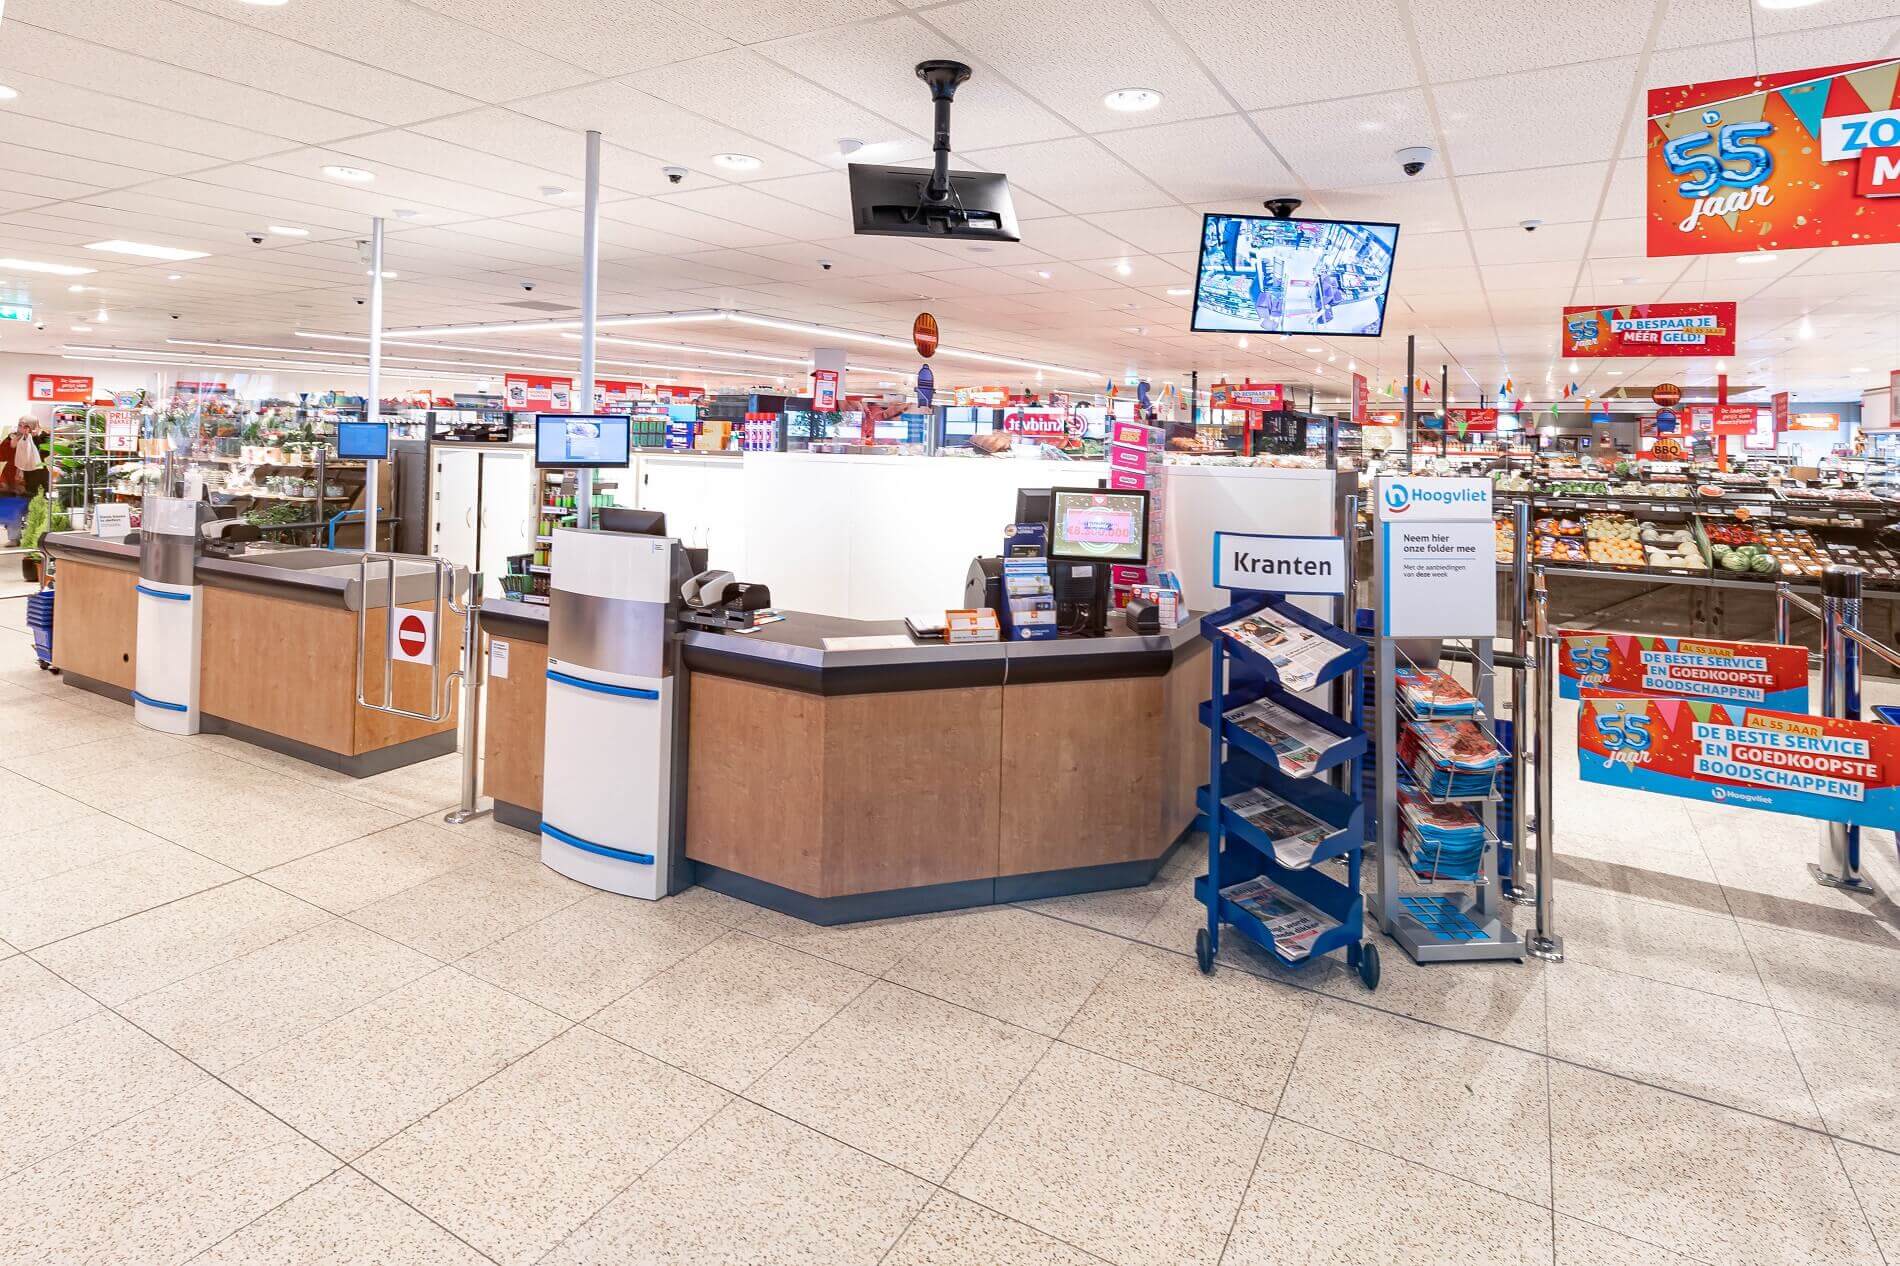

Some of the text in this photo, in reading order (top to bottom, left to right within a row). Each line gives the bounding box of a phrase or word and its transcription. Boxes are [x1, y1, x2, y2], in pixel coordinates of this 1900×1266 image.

[1663, 121, 1774, 199] 55
[1679, 184, 1775, 233] jaar
[1568, 319, 1600, 341] 55
[1616, 317, 1712, 331] ZO BESPAAR JE
[1623, 330, 1702, 343] MÉÉR GELD!
[1654, 445, 1680, 456] BBQ
[1411, 488, 1487, 504] Hoogvliet
[1403, 533, 1450, 543] Neem hier
[1403, 544, 1476, 553] onze folder mee
[1234, 551, 1332, 576] Kranten
[1426, 564, 1466, 572] aanbiedingen
[1681, 644, 1731, 657] AL 55 JAAR
[1569, 647, 1611, 675] 55
[1644, 653, 1764, 669] DE BESTE SERVICE
[1576, 672, 1612, 688] jaar
[1650, 665, 1775, 685] EN GOEDKOOPSTE
[1645, 677, 1760, 700] BOODSCHAPPEN!
[1595, 713, 1652, 751] 55
[1751, 717, 1818, 737] AL 55 JAAR
[1697, 725, 1864, 756] DE BESTE SERVICE
[1602, 746, 1653, 769] jaar
[1705, 743, 1878, 778] EN GOEDKOOPSTE
[1699, 759, 1859, 797] BOODSCHAPPEN!
[1726, 790, 1774, 805] Hoogvliet
